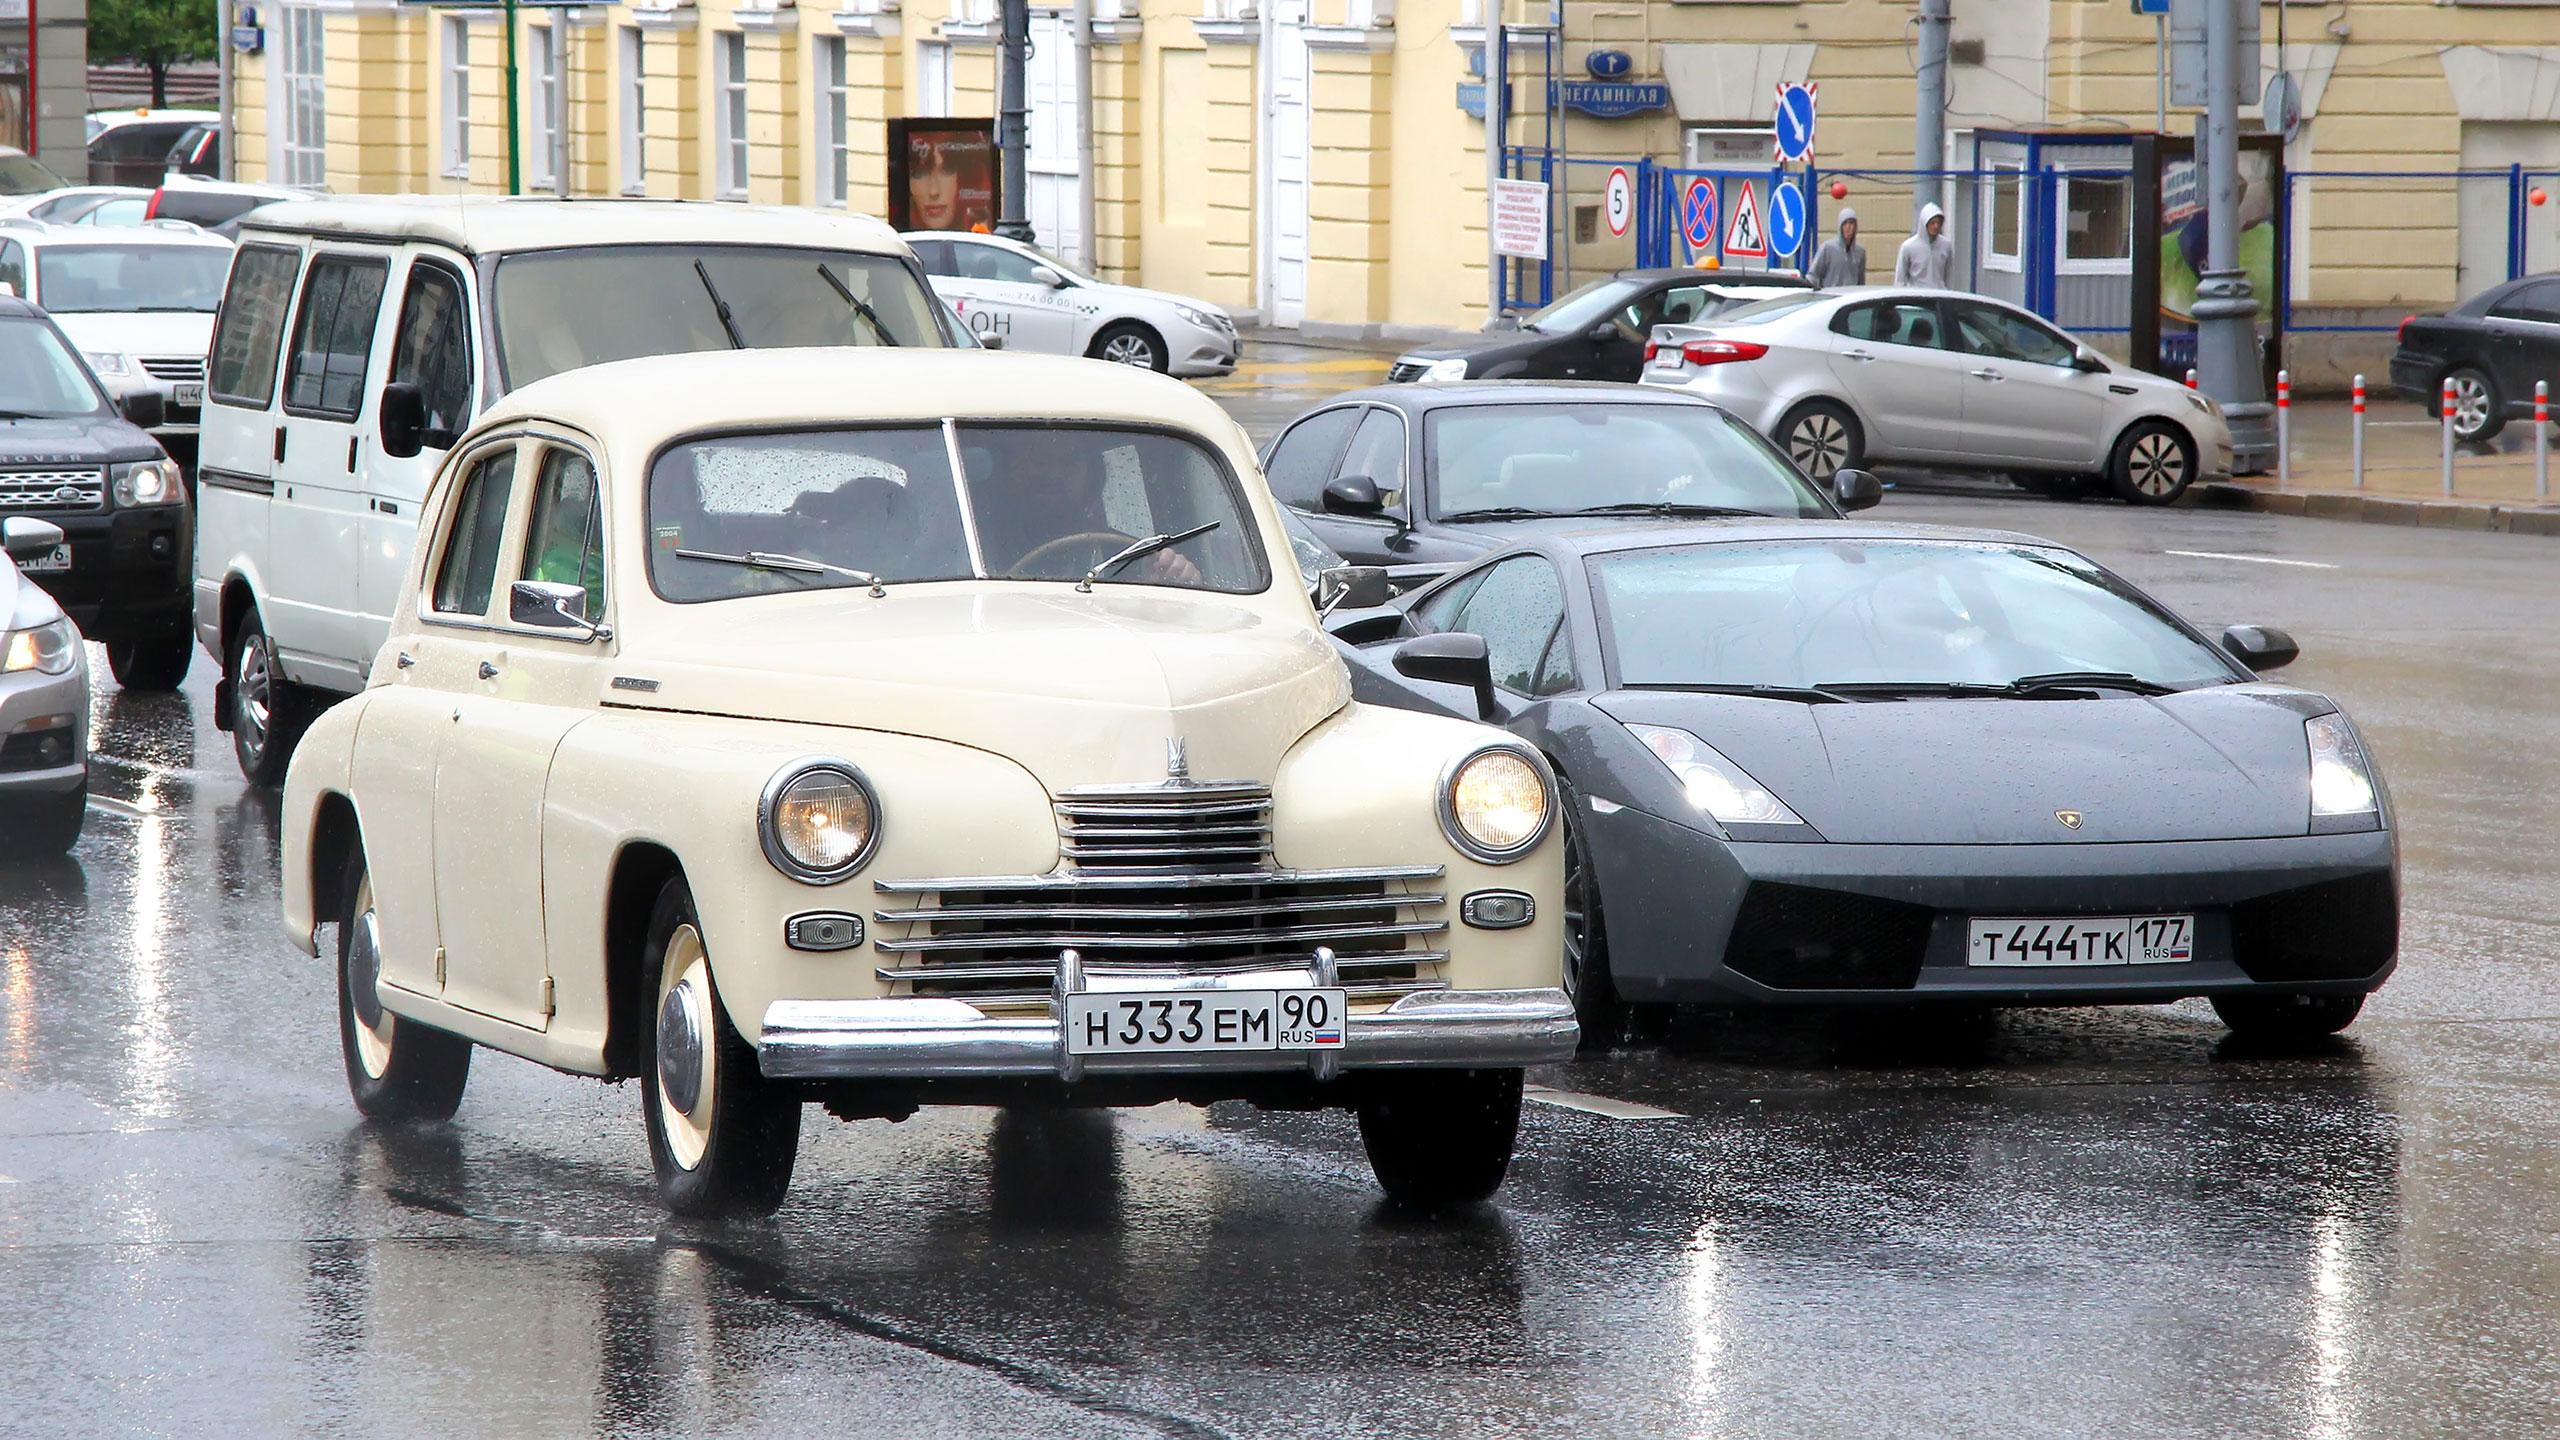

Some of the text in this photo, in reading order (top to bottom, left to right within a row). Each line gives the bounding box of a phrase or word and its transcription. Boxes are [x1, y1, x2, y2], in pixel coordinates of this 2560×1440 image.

[1607, 55, 1618, 73] 1
[1562, 87, 1658, 103] НЕГЛИННАЯ
[1614, 189, 1622, 214] 5
[1983, 924, 2125, 961] Т444ТК
[2135, 919, 2185, 948] 177
[2144, 948, 2170, 959] RUS
[1086, 1000, 1269, 1046] Н333ЕМ
[1283, 995, 1328, 1029] 90
[1280, 1031, 1313, 1044] RUS
